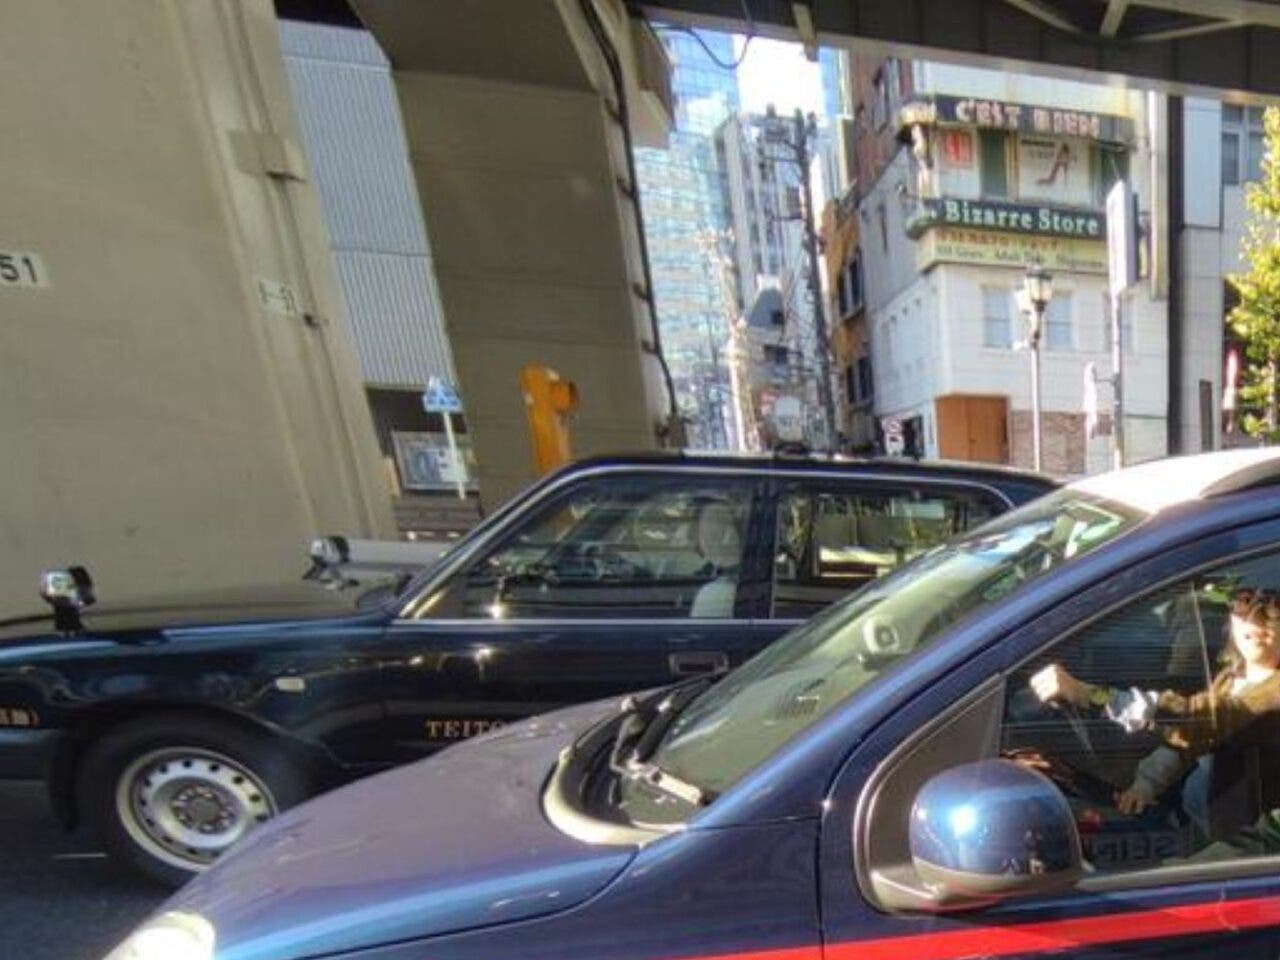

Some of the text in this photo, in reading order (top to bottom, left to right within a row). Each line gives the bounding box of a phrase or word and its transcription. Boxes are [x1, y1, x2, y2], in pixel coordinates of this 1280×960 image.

[943, 200, 1034, 229] Bizarre
[1038, 208, 1099, 235] Store
[0, 255, 37, 283] 51
